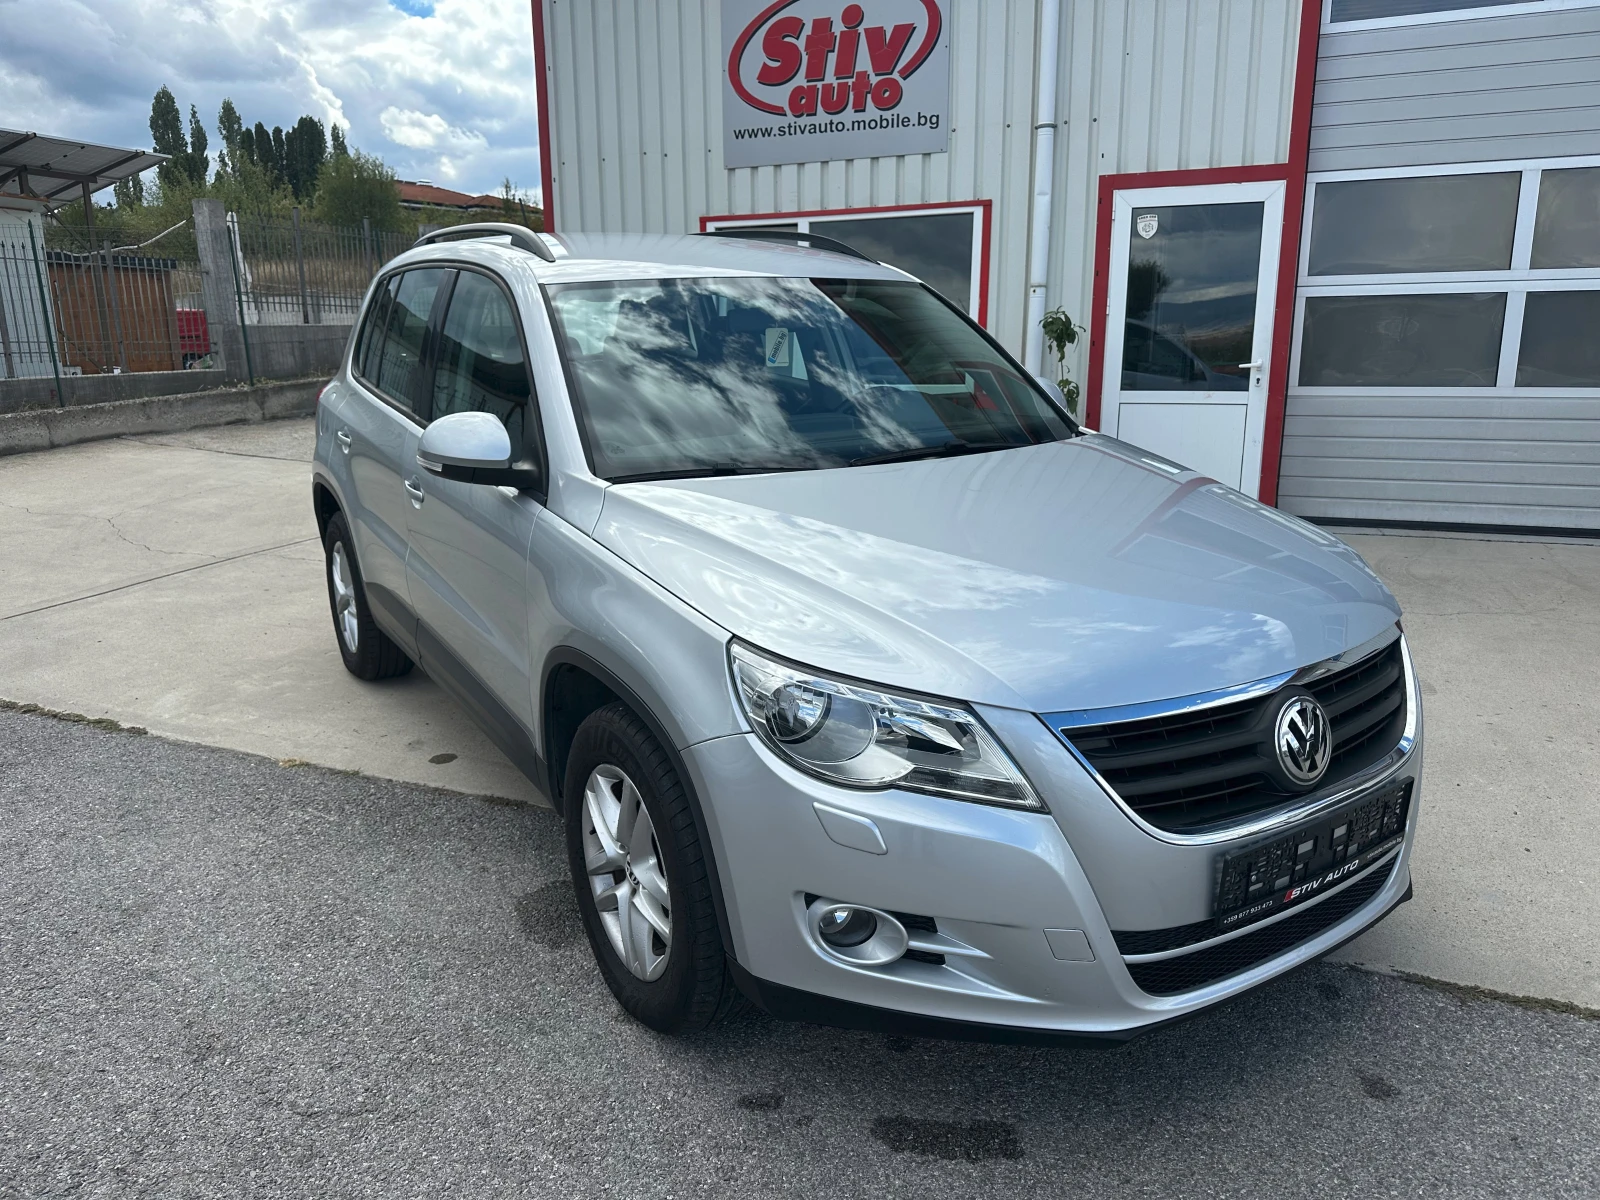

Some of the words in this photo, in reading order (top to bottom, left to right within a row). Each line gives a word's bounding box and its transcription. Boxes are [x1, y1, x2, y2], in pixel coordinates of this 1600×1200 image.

[757, 4, 916, 86] Stiv
[788, 71, 903, 118] auto
[733, 112, 940, 140] www.stivauto.mobile.bg
[1290, 877, 1323, 899] STIV
[1323, 859, 1359, 884] AUTO
